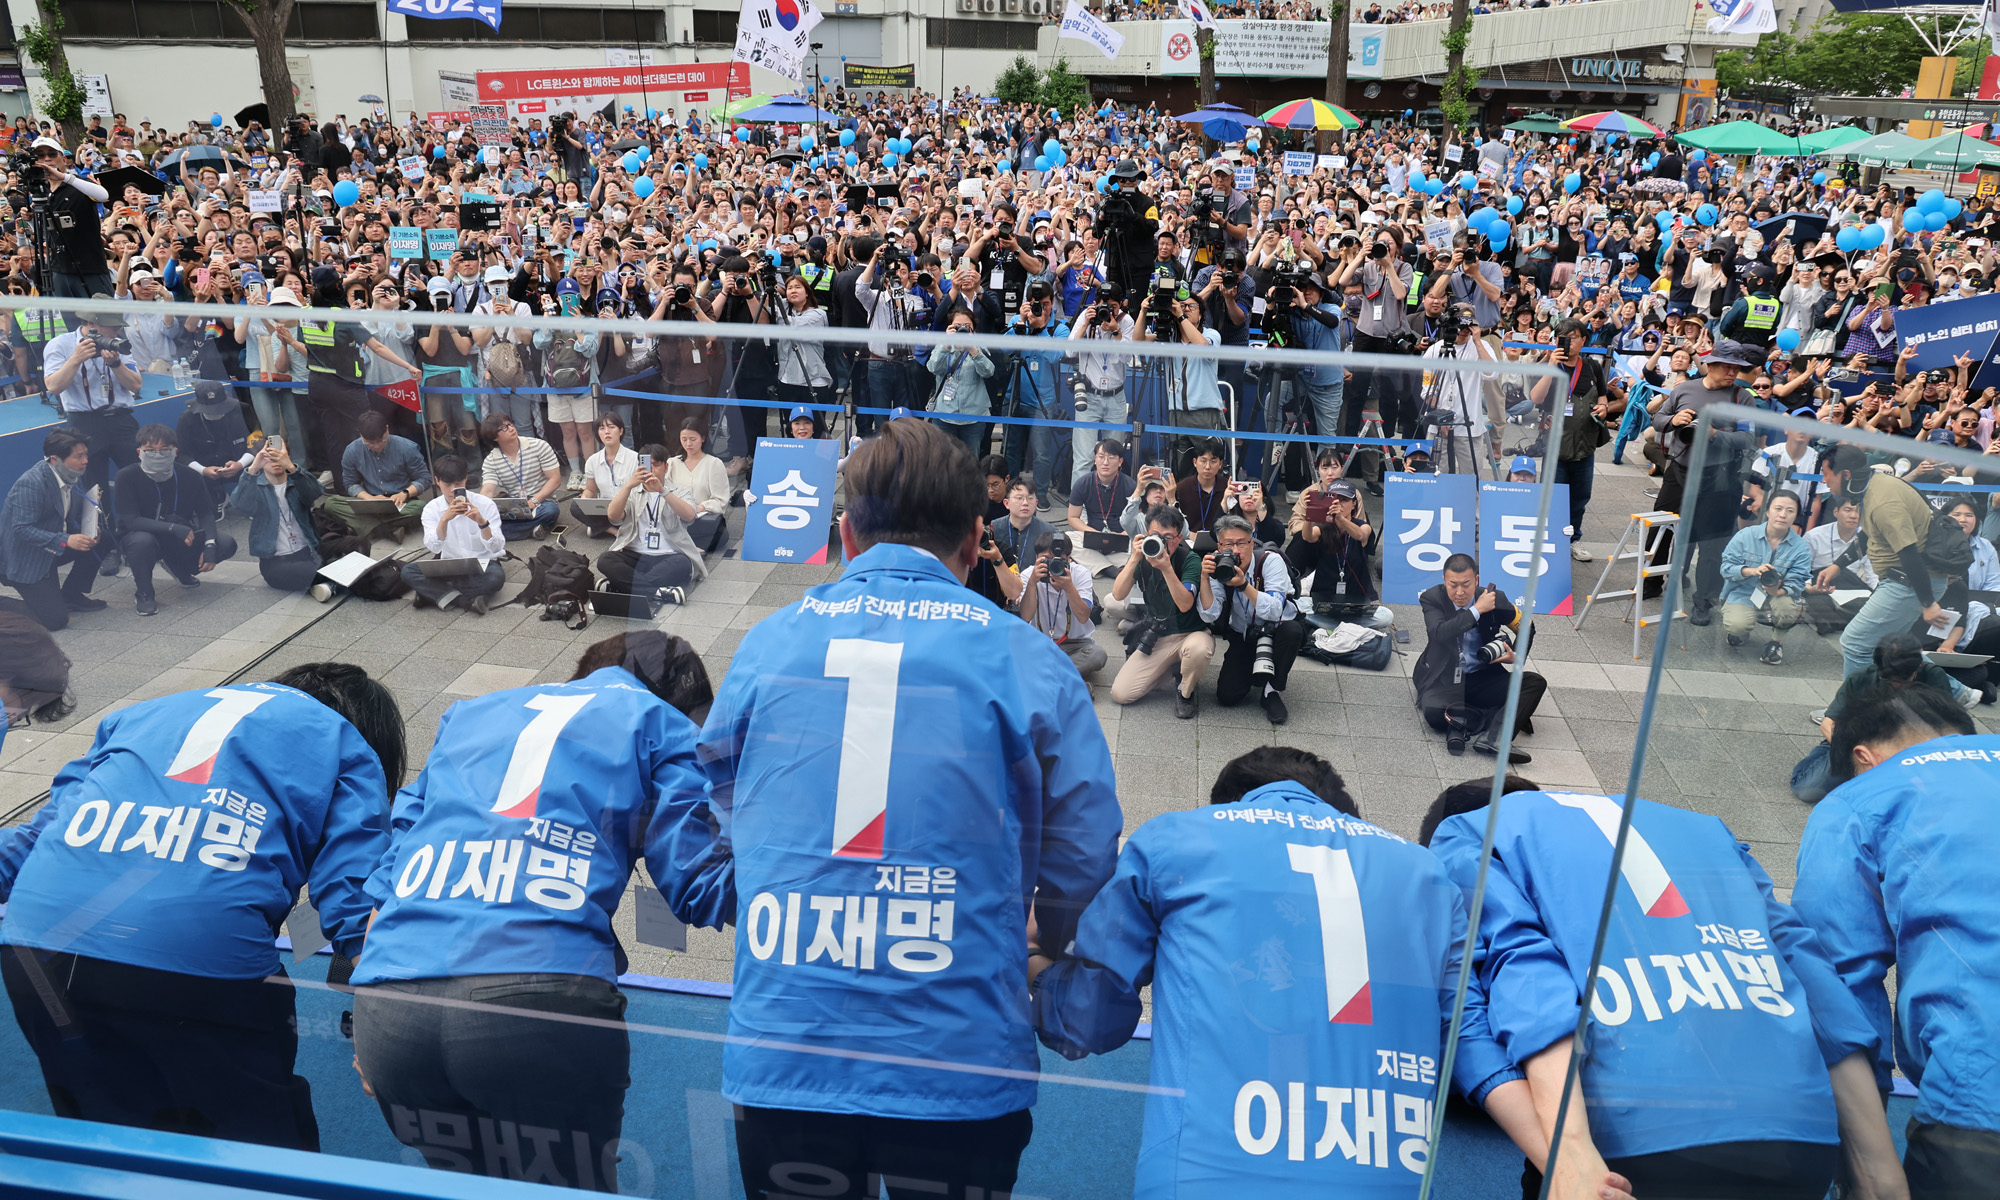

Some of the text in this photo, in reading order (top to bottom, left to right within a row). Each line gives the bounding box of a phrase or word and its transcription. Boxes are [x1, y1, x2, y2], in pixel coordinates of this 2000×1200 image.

[1063, 18, 1090, 34] 잘먹고
[1280, 23, 1293, 32] 환경
[1295, 23, 1314, 32] 캠페인
[527, 71, 705, 91] LG트윈스와 함께하는 세이브더칠드런 데이
[1572, 58, 1683, 82] UNIQUE sports
[392, 240, 419, 250] 이재명
[430, 241, 456, 251] 이재명
[1927, 328, 1949, 342] 노인
[1951, 324, 1973, 337] 쉼터
[1975, 320, 1998, 333] 설치
[387, 388, 417, 401] 42기-3
[762, 469, 820, 530] 송
[774, 549, 794, 557] 민주당
[1398, 507, 1461, 571] 강
[1494, 515, 1556, 578] 동
[864, 595, 906, 620] 진짜
[907, 599, 991, 626] 대한민국
[164, 688, 277, 785] 1
[824, 638, 904, 858] 1
[489, 693, 597, 818] 1
[1901, 749, 1992, 766] 이제부터
[201, 787, 268, 826] 지금은
[1213, 808, 1296, 828] 이제부터
[1297, 813, 1336, 832] 진짜
[64, 799, 263, 872] 이재명
[524, 817, 597, 856] 지금은
[1544, 792, 1691, 918] 1
[395, 839, 591, 911] 이재명
[875, 866, 956, 894] 지금은
[747, 891, 955, 973] 이재명
[1285, 842, 1373, 1026] 1
[1695, 923, 1768, 950] 지금은
[1586, 949, 1795, 1027] 이재명
[1376, 1049, 1436, 1085] 지금은
[1233, 1079, 1435, 1175] 이재명
